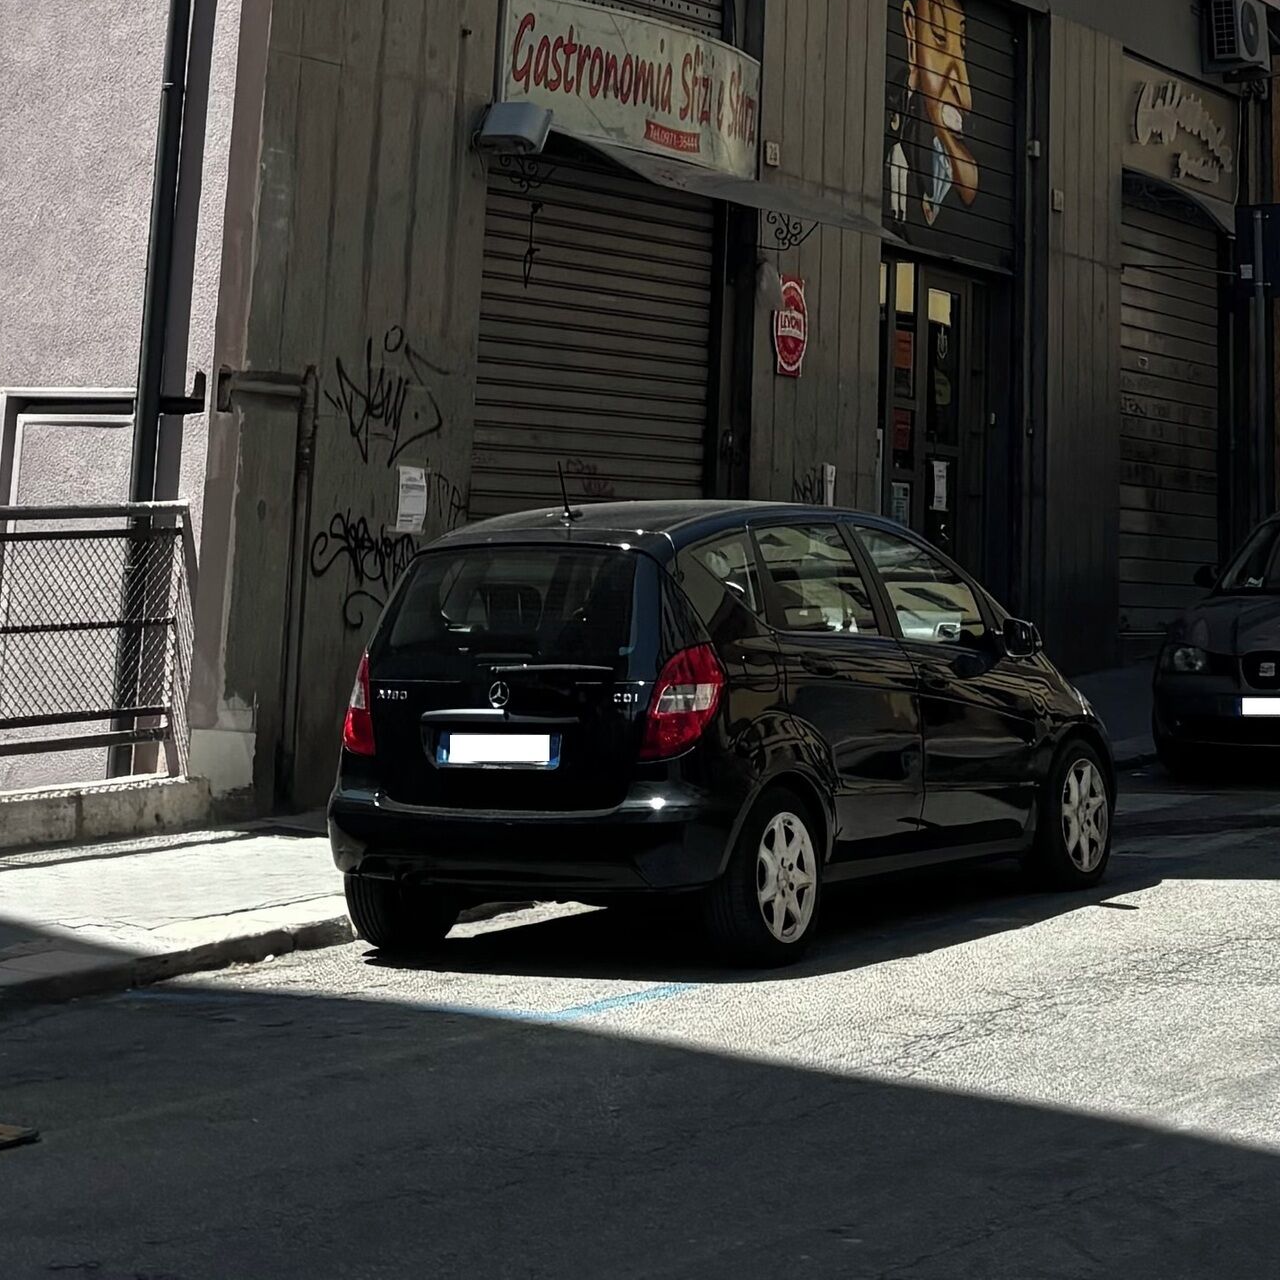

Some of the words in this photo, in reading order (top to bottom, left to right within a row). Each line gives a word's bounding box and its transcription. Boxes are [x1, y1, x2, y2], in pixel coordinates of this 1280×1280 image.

[511, 12, 673, 115] Gastronomia
[678, 43, 714, 127] Sfizi
[716, 80, 725, 133] e
[612, 692, 639, 703] CDI
